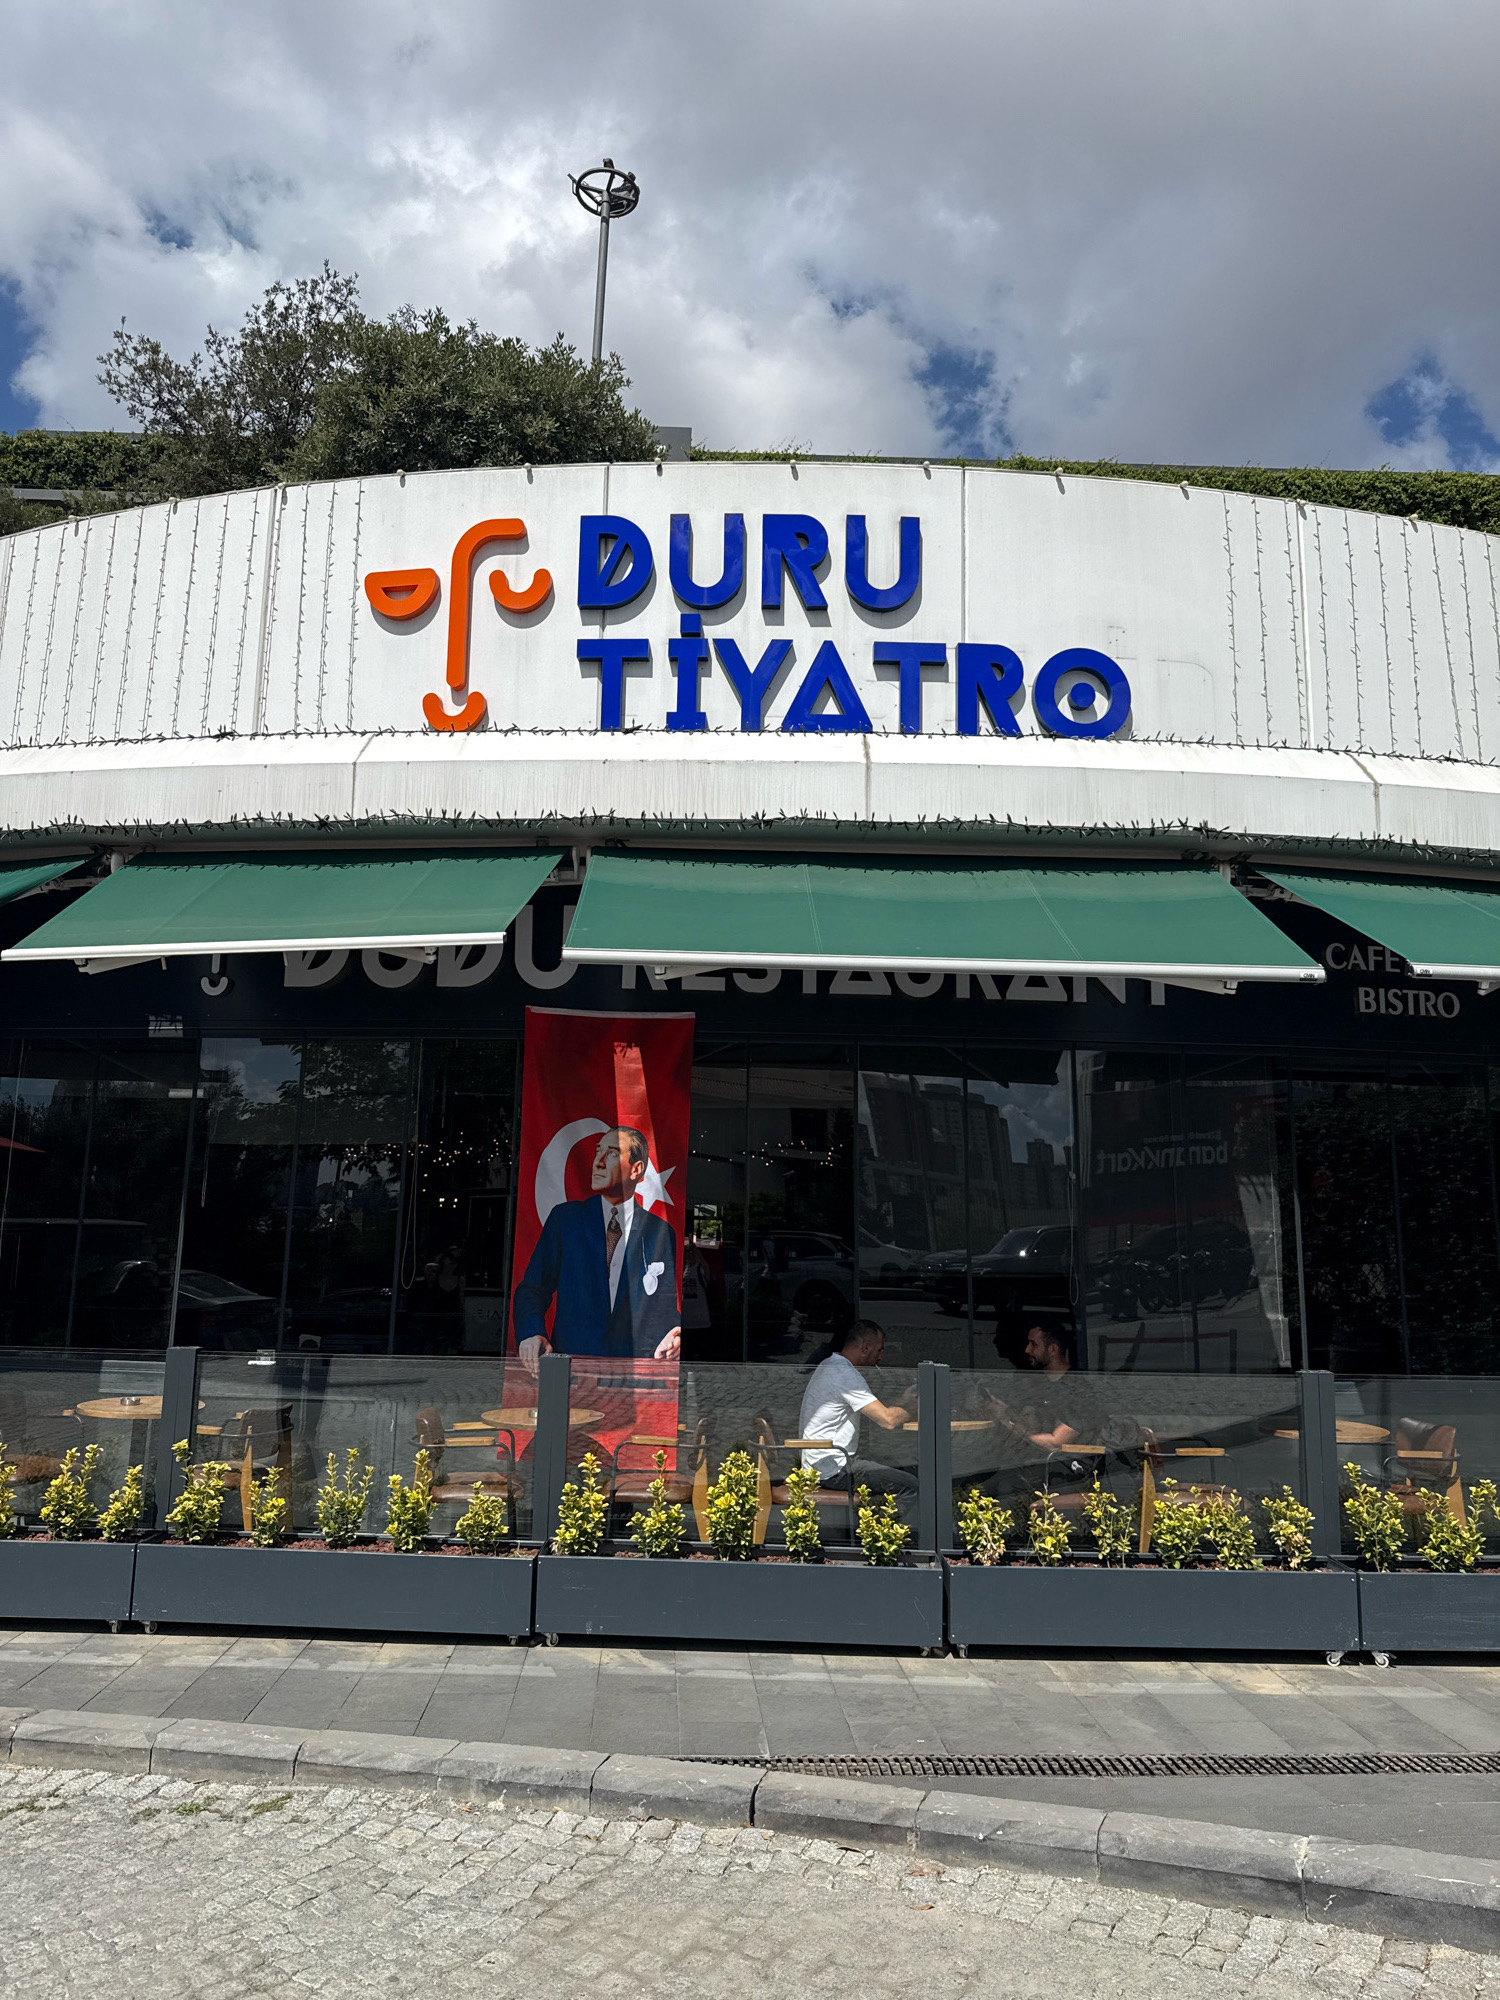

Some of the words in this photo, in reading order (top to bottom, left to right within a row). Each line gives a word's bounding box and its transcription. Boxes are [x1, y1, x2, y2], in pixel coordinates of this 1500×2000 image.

[577, 513, 921, 609] DURU
[577, 613, 1132, 739] TİYATRO
[1325, 942, 1401, 973] CAFE
[1358, 986, 1461, 1019] BISTRO
